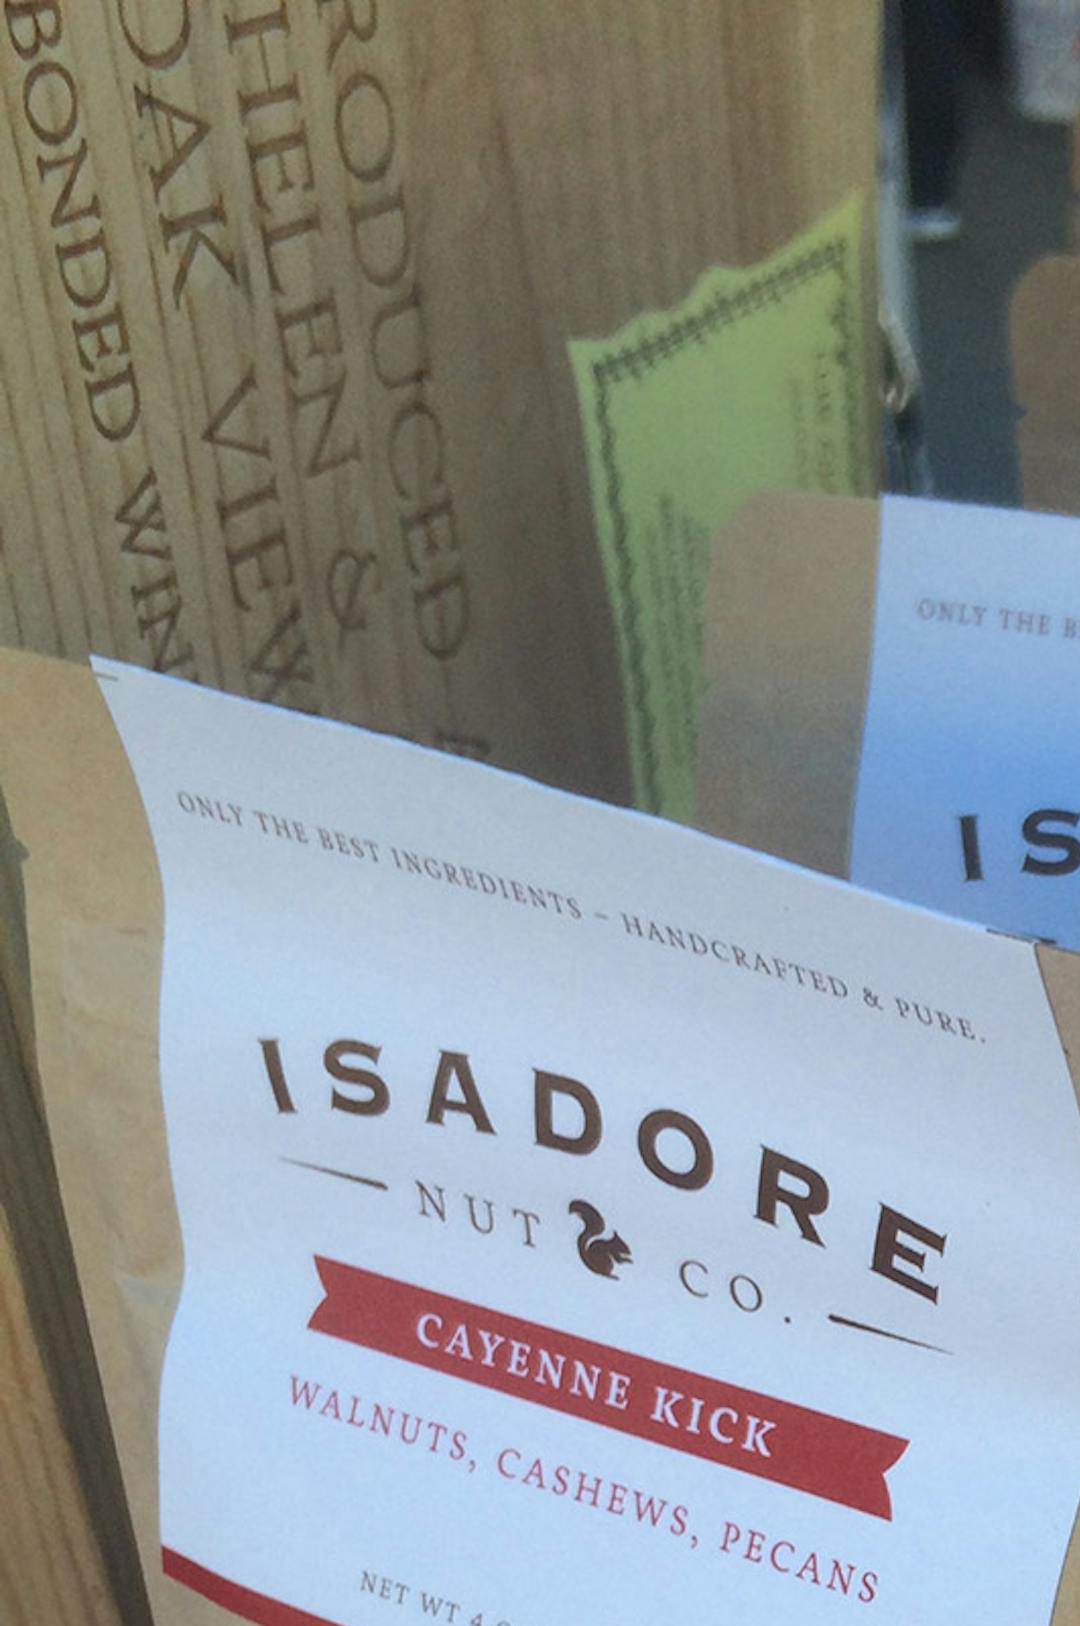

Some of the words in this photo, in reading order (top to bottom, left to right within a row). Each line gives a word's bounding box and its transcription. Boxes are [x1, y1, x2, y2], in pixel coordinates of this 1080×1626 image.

[4, 0, 141, 442] BONDED
[115, 466, 196, 682] WIN
[315, 0, 472, 660] RODUCED
[916, 598, 988, 627] ONLY
[999, 608, 1051, 636] THE
[177, 791, 244, 827] ONLY
[252, 810, 309, 845] THE
[317, 829, 380, 863] BEST
[390, 847, 583, 919] INGREDIENTS
[620, 912, 849, 999] HANDCRAFTED
[862, 986, 884, 1011] &
[894, 996, 988, 1044] PURE.
[256, 1036, 949, 1305] ISADORE
[417, 1179, 541, 1249] NUT
[677, 1259, 793, 1325] CO.
[288, 1374, 478, 1474] WALNUTS,
[496, 1446, 700, 1549] CASHEWS,
[720, 1520, 880, 1604] PECANS
[415, 1312, 633, 1411] CAYENNE
[649, 1386, 778, 1458] KICK
[359, 1569, 411, 1606] NET
[420, 1592, 462, 1625] WT
